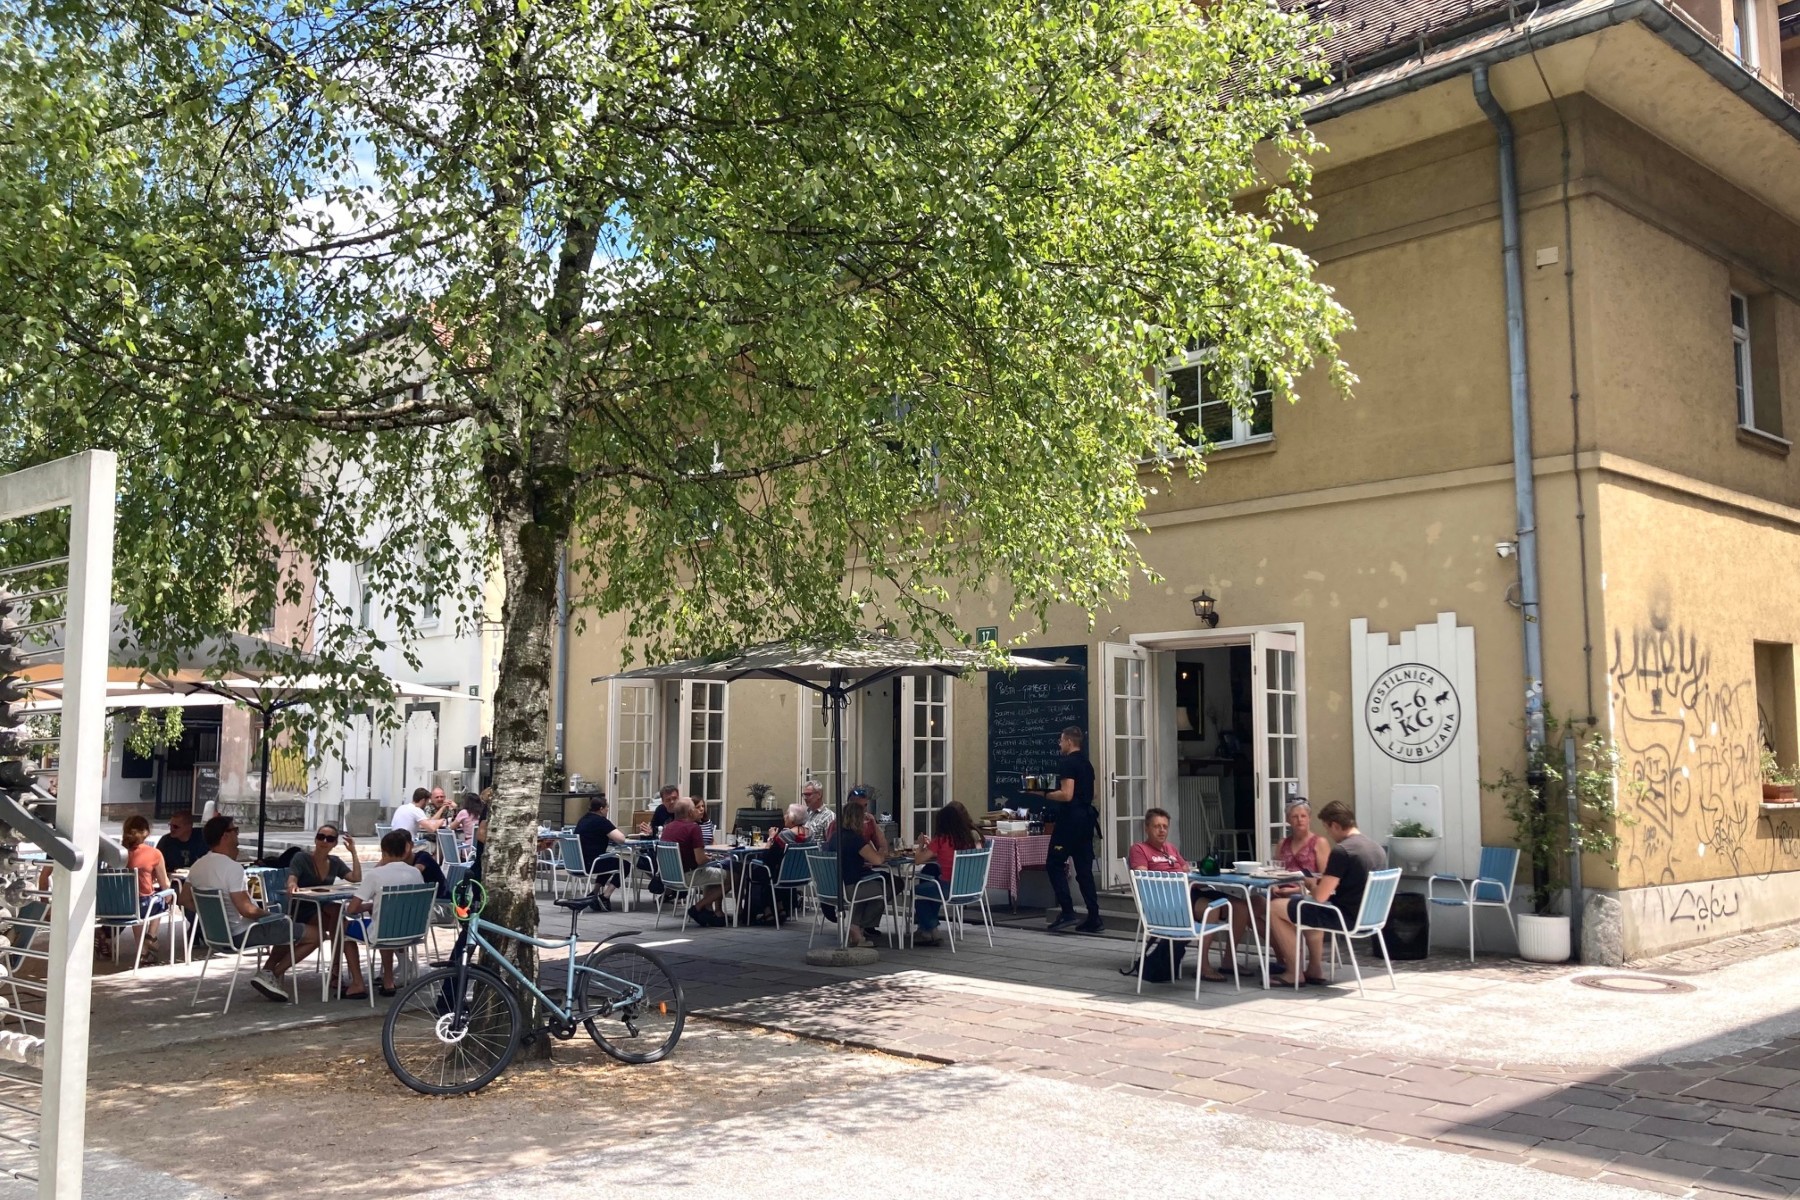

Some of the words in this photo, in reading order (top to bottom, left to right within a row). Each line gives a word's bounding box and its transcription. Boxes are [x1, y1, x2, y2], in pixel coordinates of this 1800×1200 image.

[1371, 670, 1434, 714] GOSTILNICA
[1390, 688, 1427, 720] 5-6
[1388, 713, 1455, 757] LJUBLJANA
[1398, 708, 1434, 738] KG
